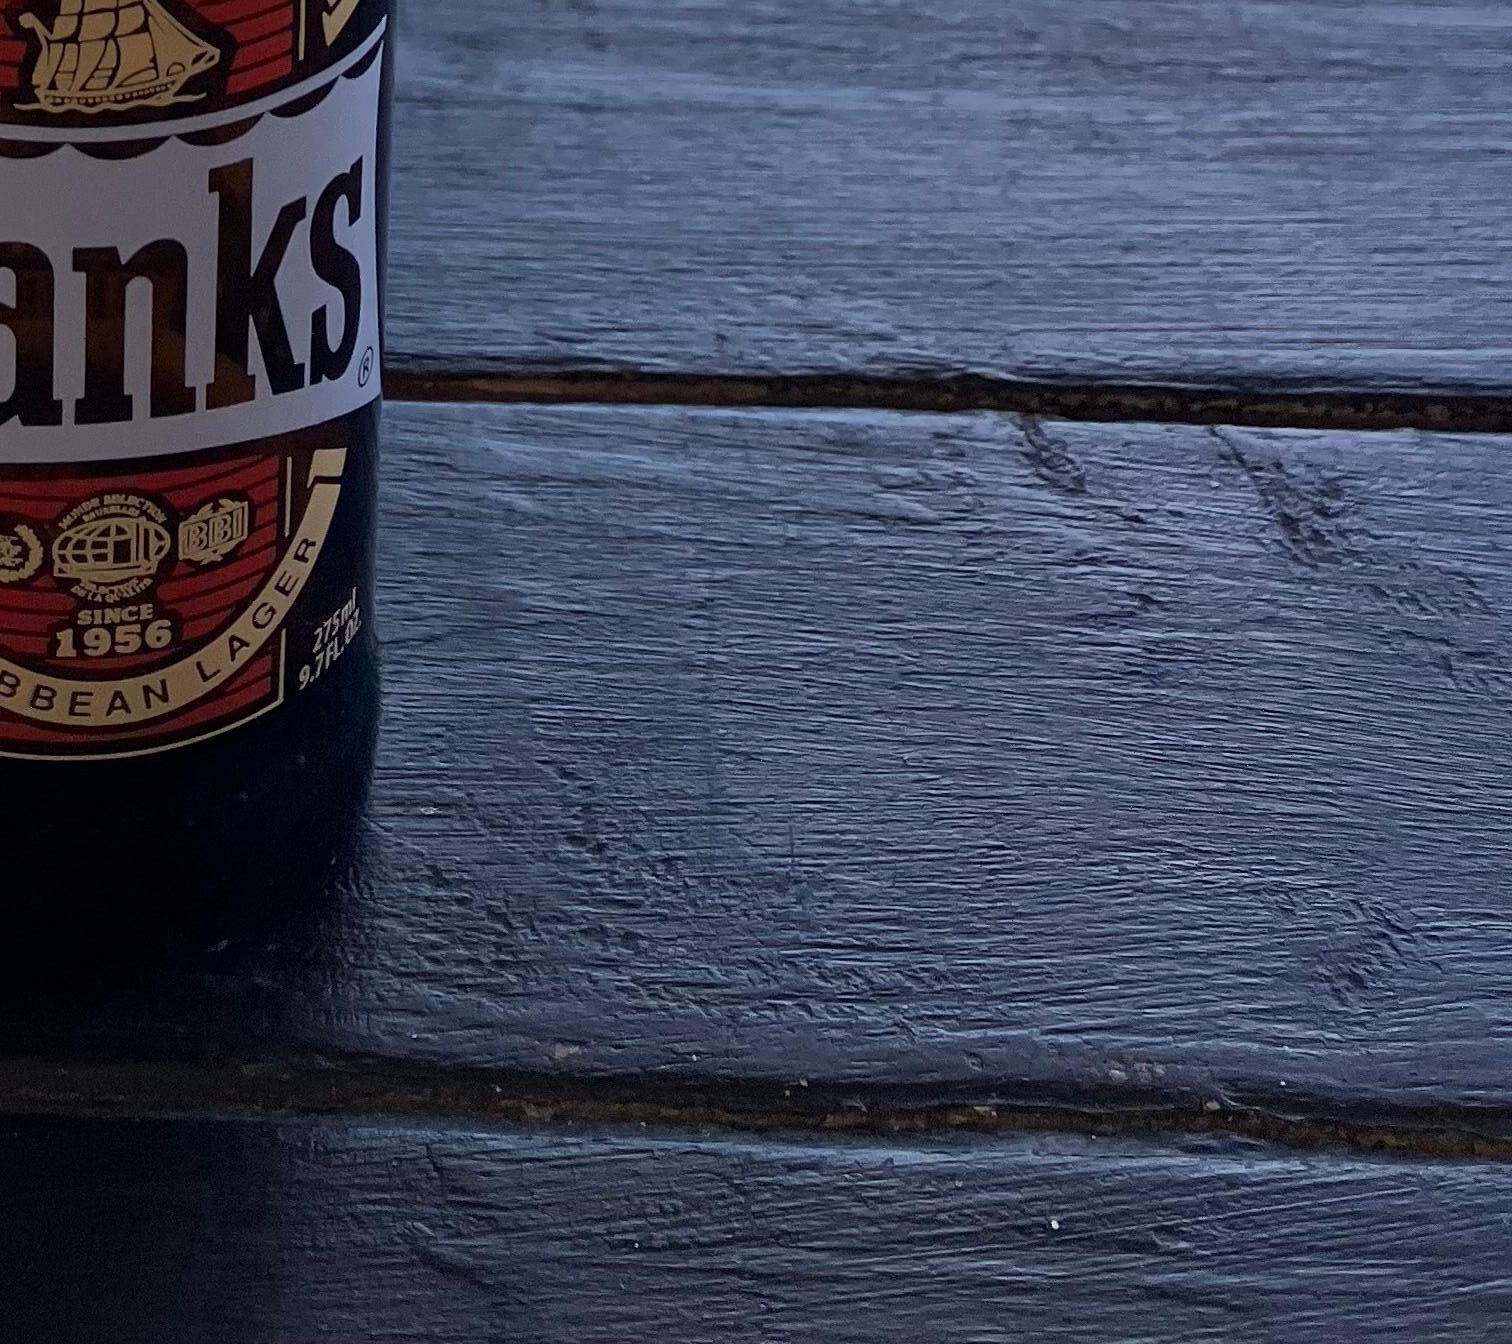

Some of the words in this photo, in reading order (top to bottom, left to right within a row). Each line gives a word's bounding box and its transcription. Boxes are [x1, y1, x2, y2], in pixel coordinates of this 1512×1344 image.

[76, 603, 154, 626] SINCE
[195, 535, 318, 682] LAGER
[312, 586, 357, 653] 275ml
[55, 619, 173, 658] 1956
